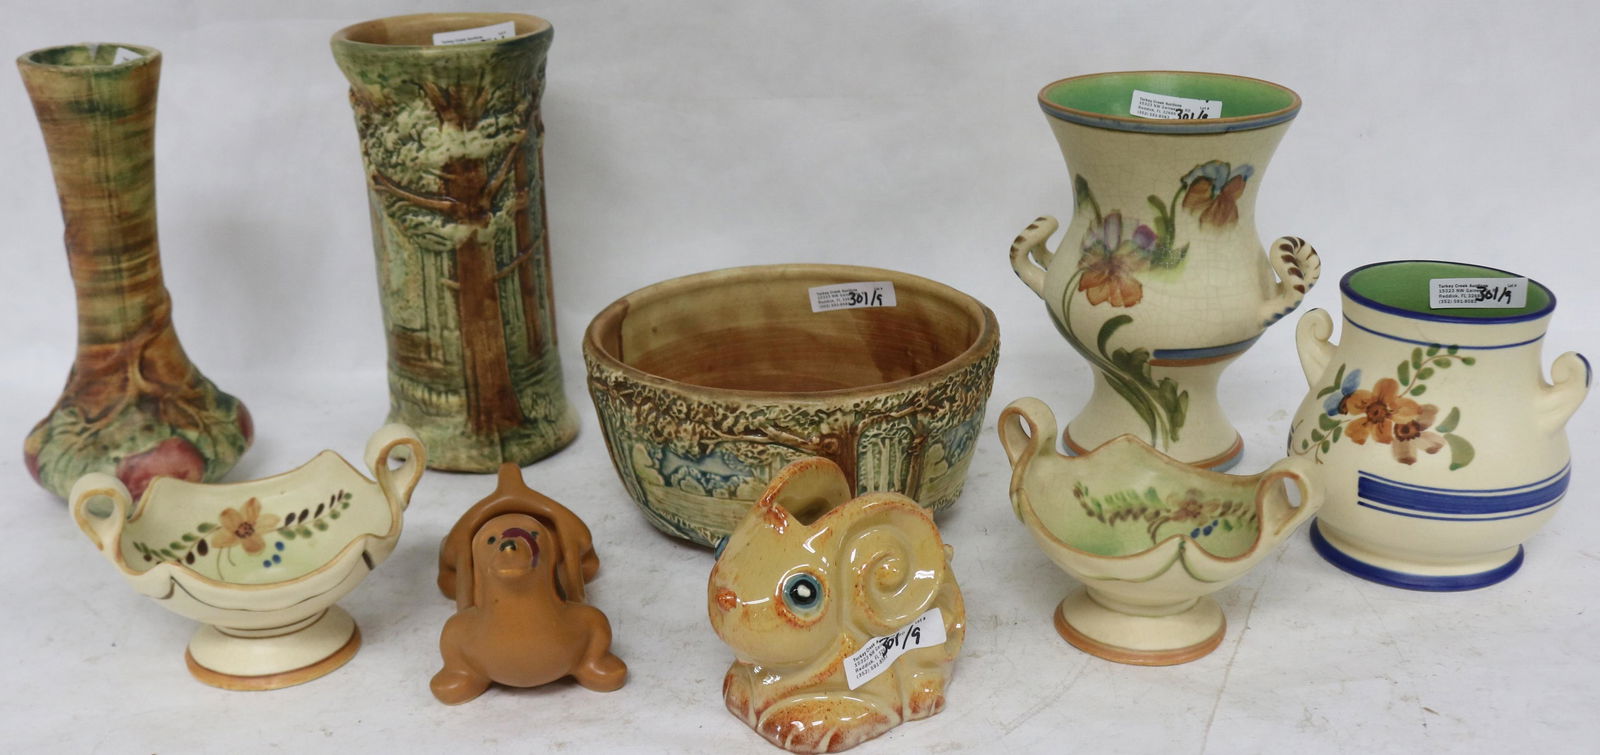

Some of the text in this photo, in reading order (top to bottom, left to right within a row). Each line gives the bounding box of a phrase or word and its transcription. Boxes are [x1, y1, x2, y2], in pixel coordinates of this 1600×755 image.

[848, 290, 882, 306] 301/9
[1476, 286, 1512, 304] 301/9
[880, 625, 920, 657] 301/9
[853, 652, 866, 662] Turkey
[866, 643, 875, 652] Creek
